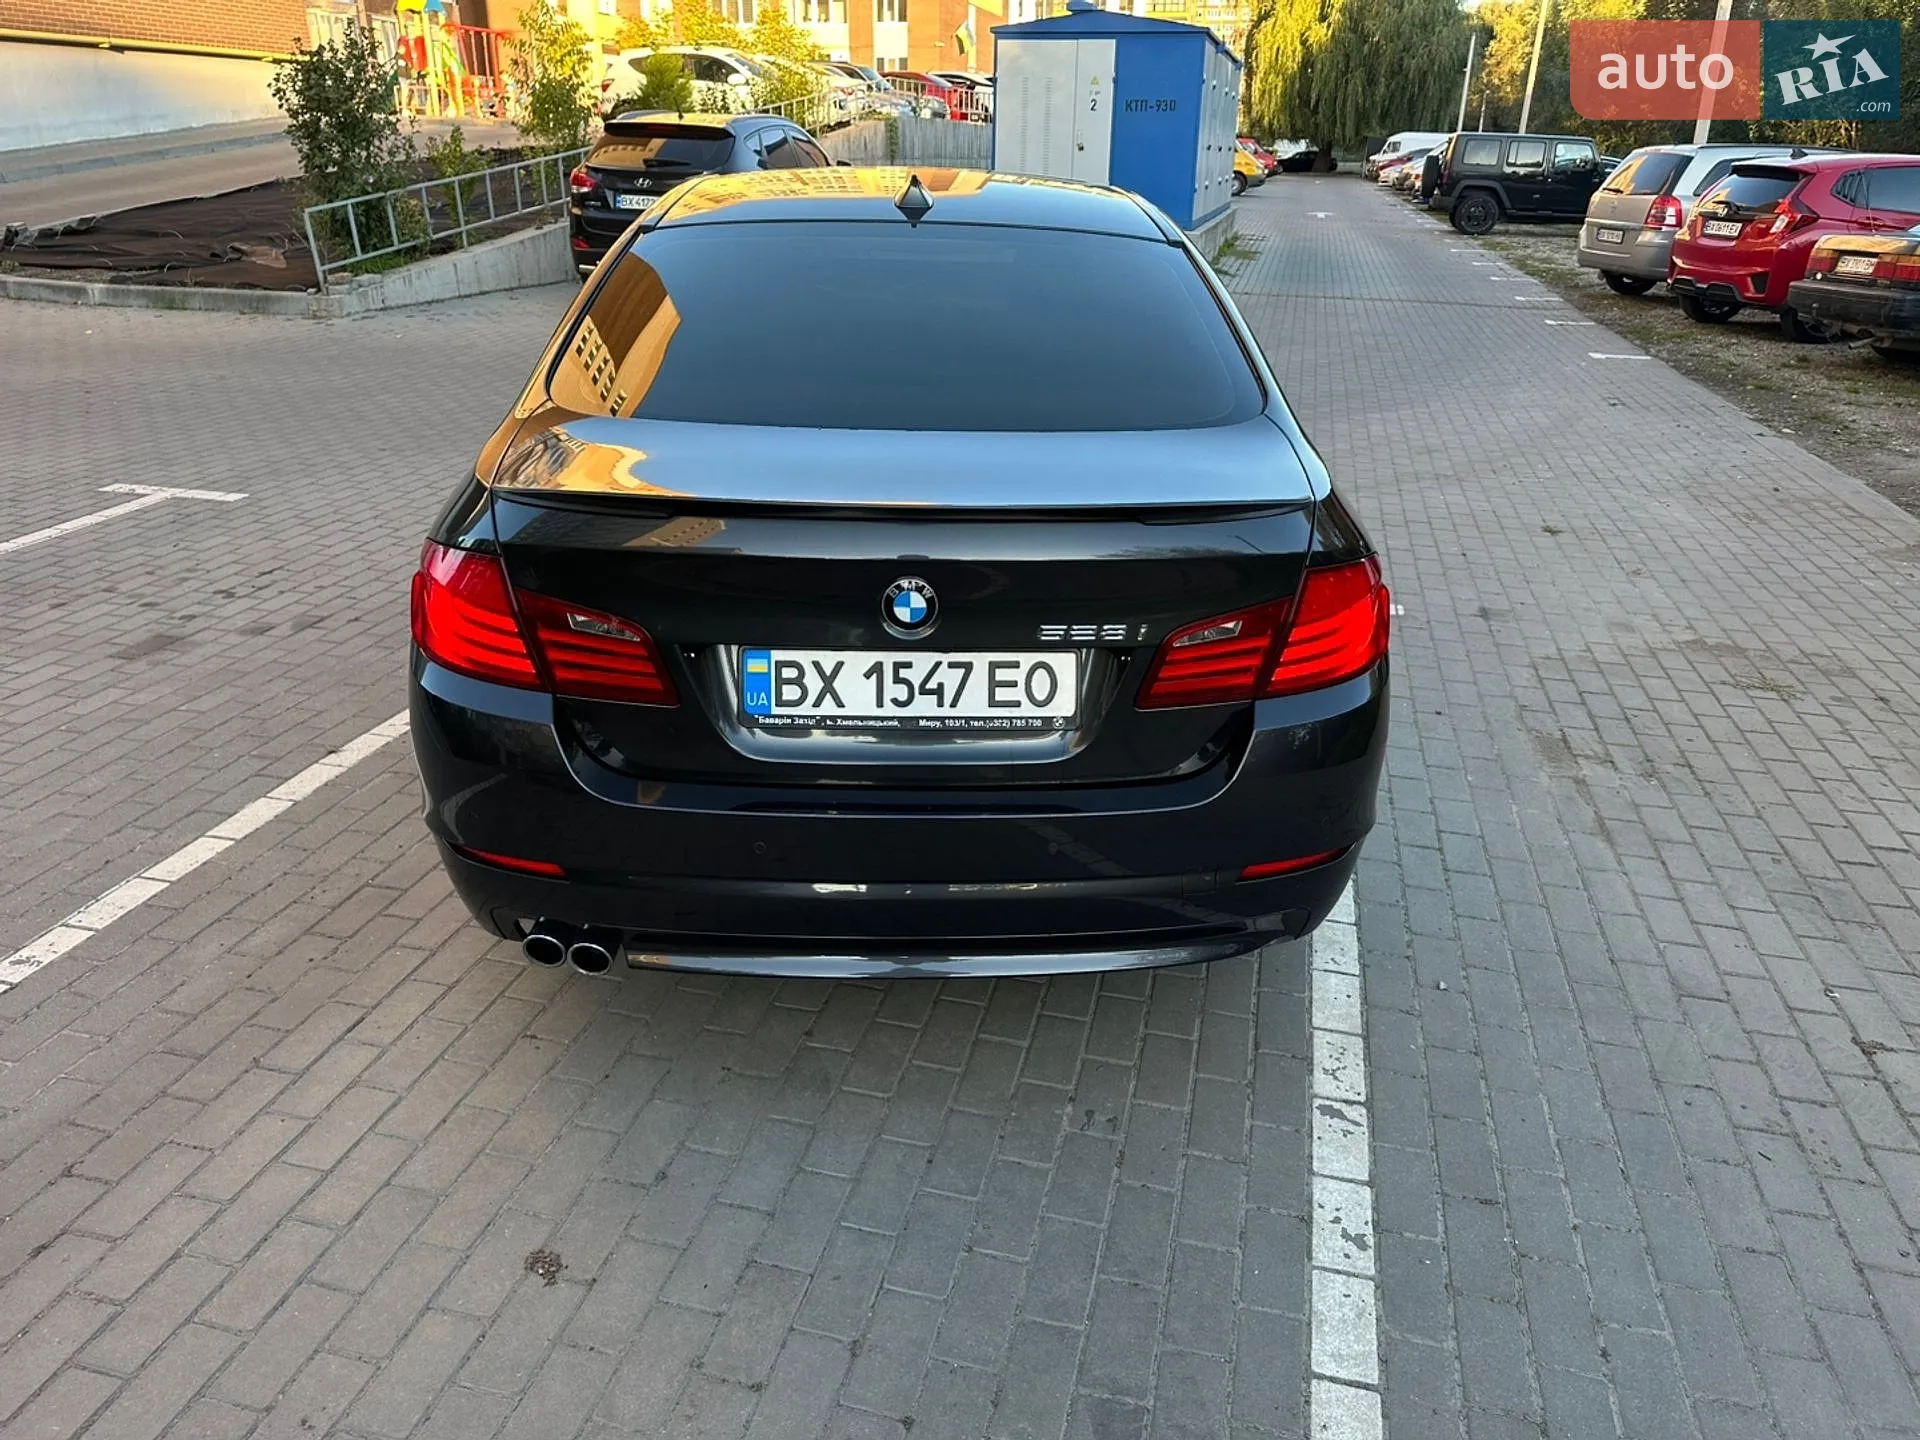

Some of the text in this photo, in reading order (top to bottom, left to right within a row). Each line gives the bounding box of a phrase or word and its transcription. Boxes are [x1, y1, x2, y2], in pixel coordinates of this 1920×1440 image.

[1090, 98, 1098, 111] 2
[888, 580, 934, 599] BMW
[747, 690, 768, 706] UA
